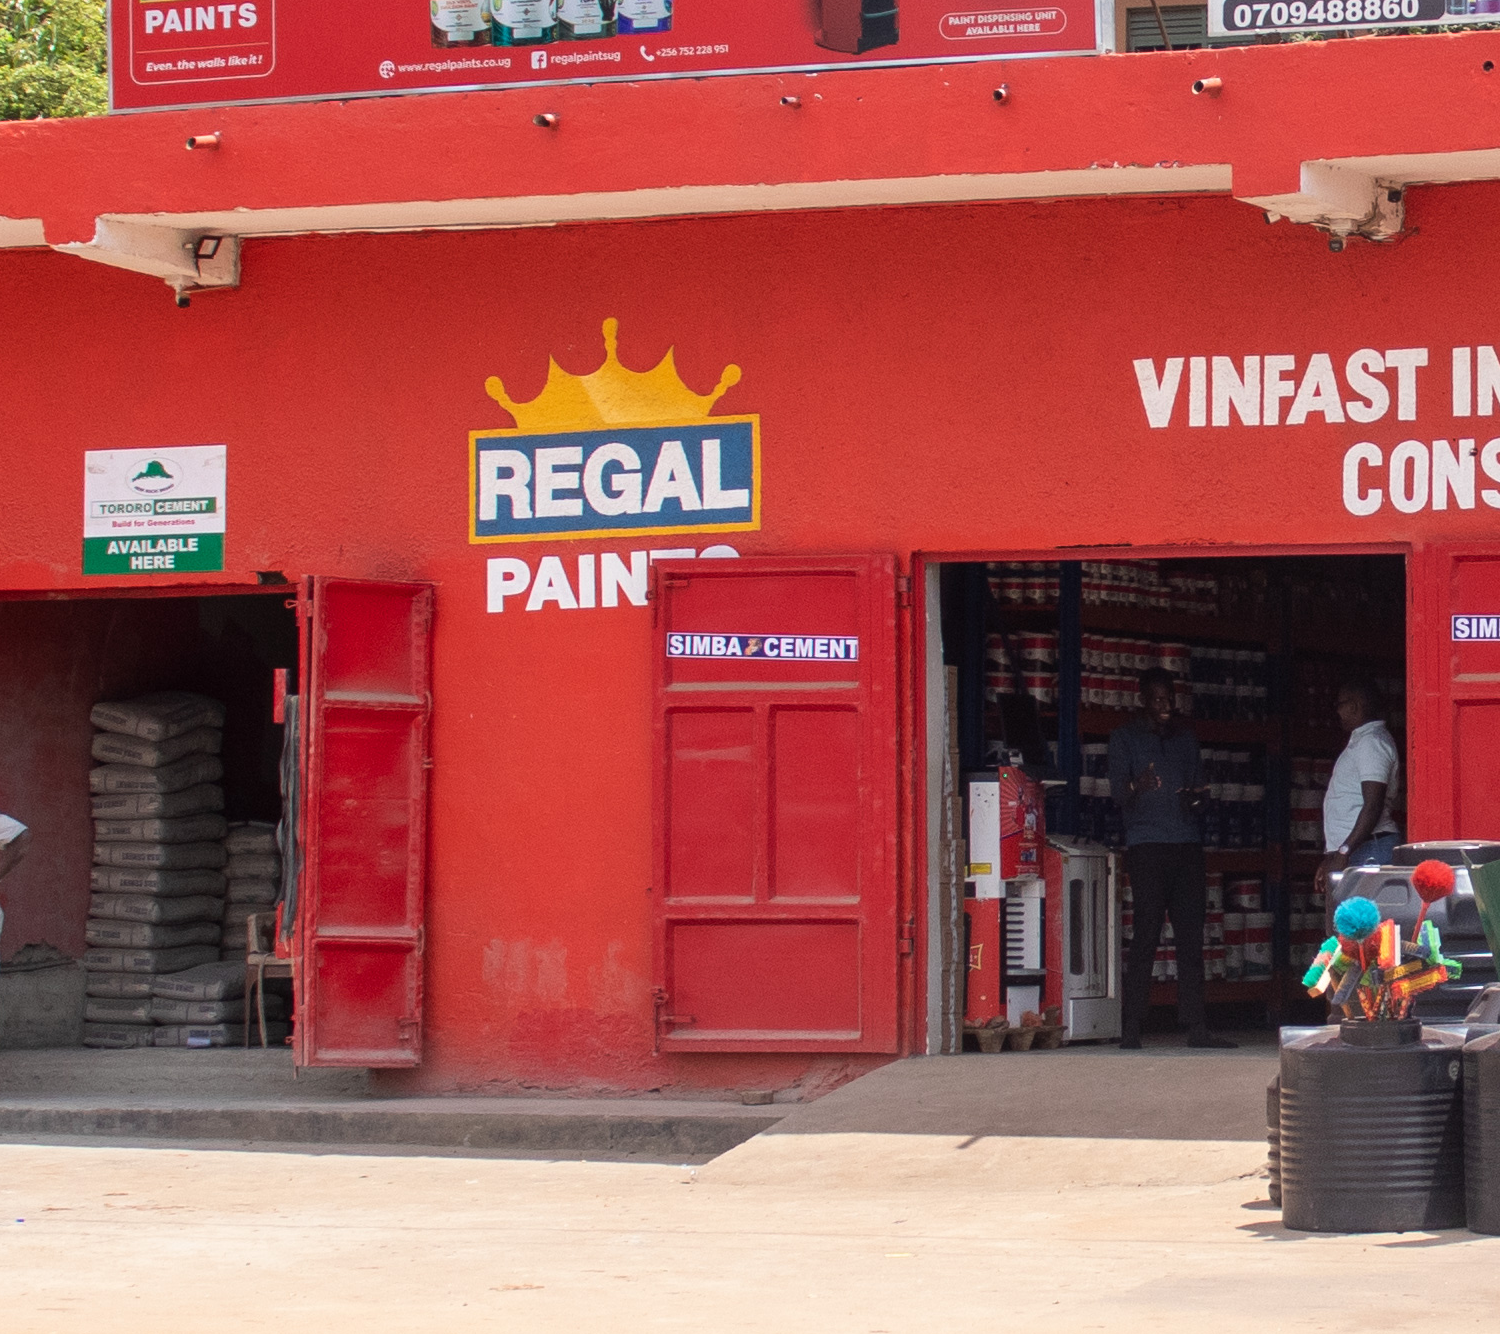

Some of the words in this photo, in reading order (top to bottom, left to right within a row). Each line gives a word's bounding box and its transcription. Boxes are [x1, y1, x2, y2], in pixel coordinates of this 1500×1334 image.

[145, 3, 257, 34] PAINTS
[948, 16, 976, 25] PAINT
[978, 13, 1033, 24] DISPENSING
[1035, 11, 1057, 20] UNIT
[966, 25, 1015, 36] AVAILABLE
[1017, 23, 1041, 33] HERE
[551, 50, 620, 65] regalpaintsug
[656, 47, 677, 58] +256
[679, 47, 695, 56] 752
[696, 46, 712, 55] 228
[713, 44, 729, 55] 951
[198, 57, 225, 69] walls
[228, 55, 247, 66] like
[398, 57, 511, 73] www.regalpaints.co.ug
[1133, 347, 1428, 428] VINFAST
[478, 438, 750, 521] REGAL
[100, 503, 152, 514] TORORO
[155, 500, 208, 512] CEMENT
[112, 520, 132, 528] Build
[133, 519, 145, 527] for
[147, 518, 195, 527] Generations
[107, 538, 198, 554] AVAILABLE
[130, 555, 175, 569] HERE
[486, 545, 741, 614] PAIN
[670, 635, 742, 656] SIMBA
[764, 638, 858, 659] CEMENT
